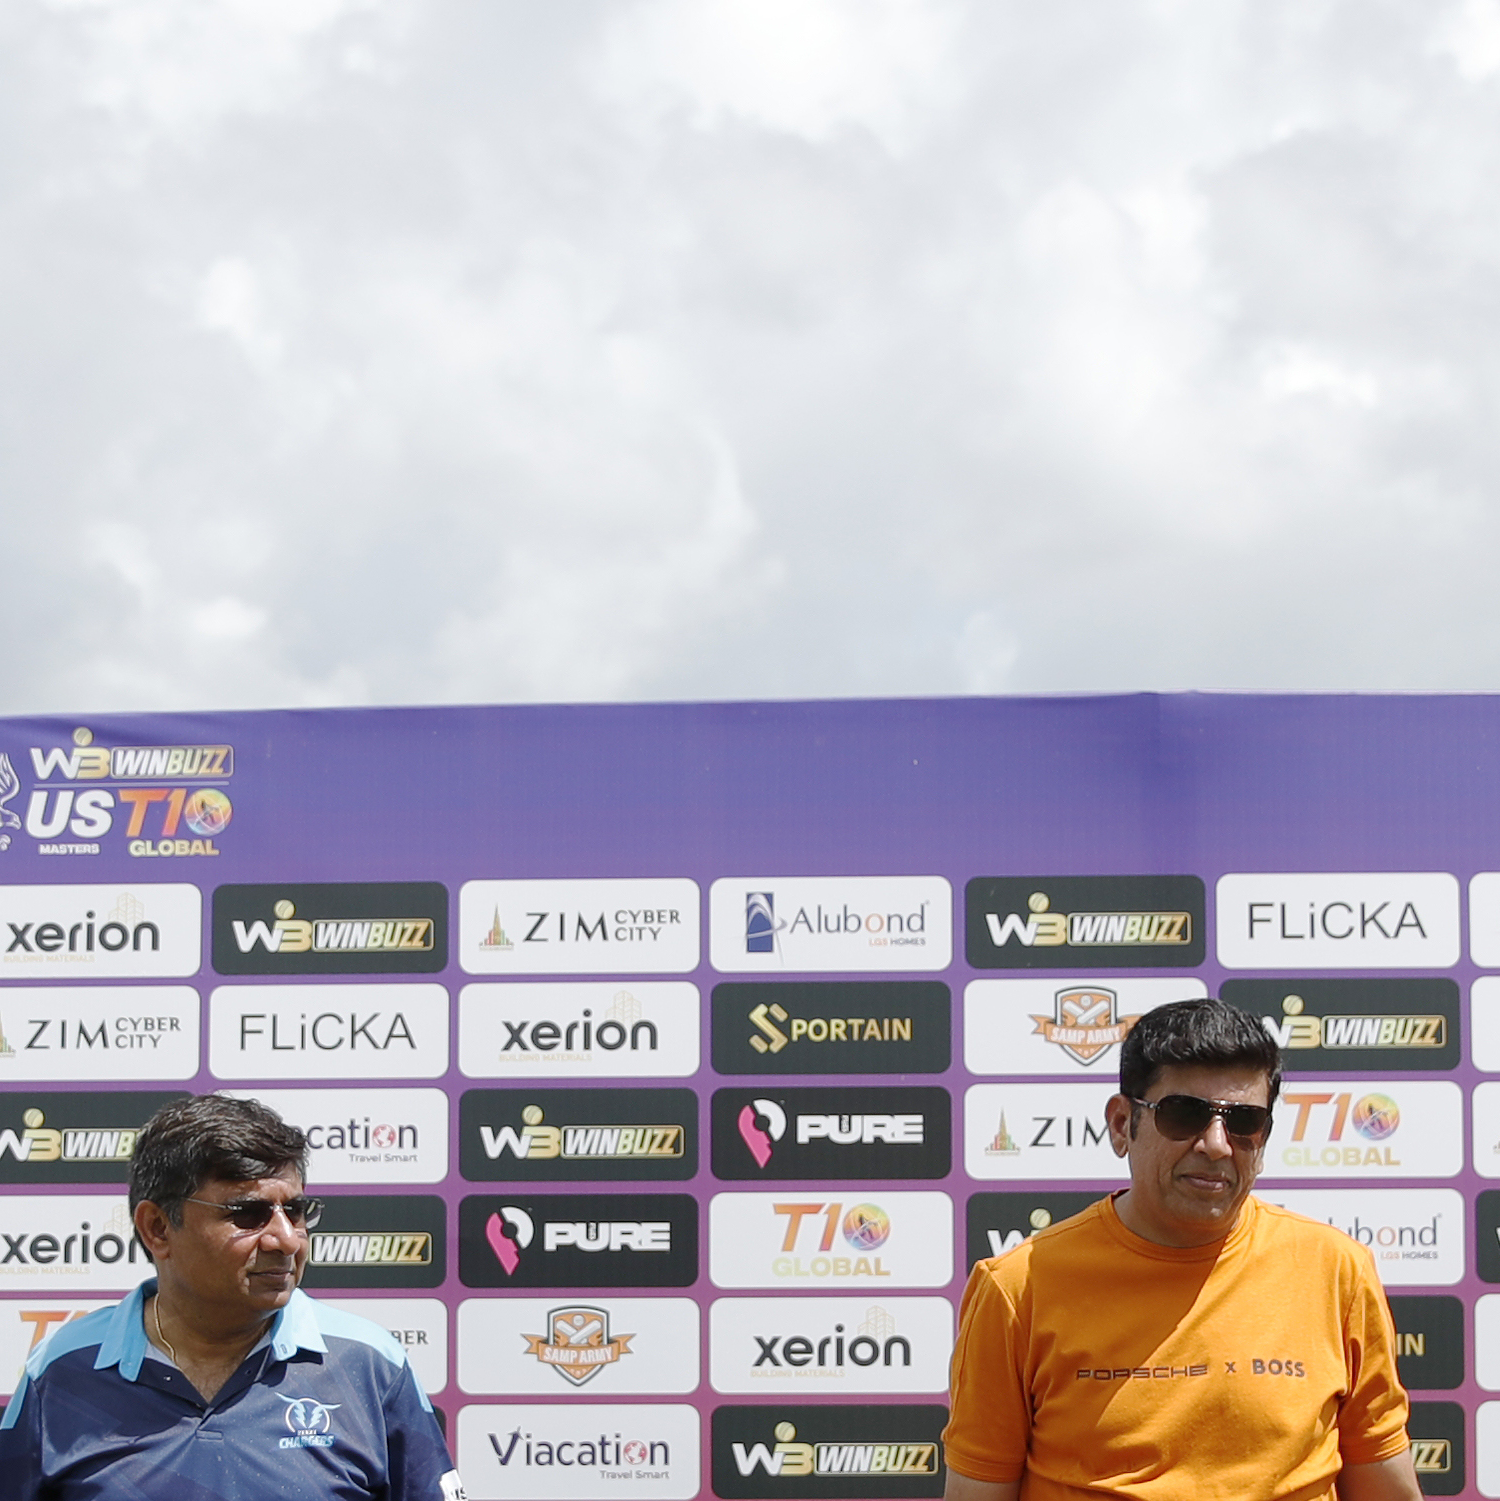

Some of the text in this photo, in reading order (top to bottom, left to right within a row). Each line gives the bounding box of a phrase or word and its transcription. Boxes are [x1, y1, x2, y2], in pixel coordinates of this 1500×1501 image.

[117, 748, 229, 776] WINBUZZ
[26, 790, 115, 838] US
[39, 844, 100, 855] MASTERS
[129, 840, 219, 856] GLOBAL
[7, 912, 159, 953] xerion
[525, 910, 681, 943] ZIM CYBER
[615, 926, 660, 942] CITY
[1069, 915, 1190, 944] WINBUZZ
[1249, 902, 1426, 940] FLiCKA
[749, 1003, 912, 1054] SPORTAIN
[797, 1114, 924, 1144] PURE
[773, 1203, 891, 1252] T10
[771, 1258, 890, 1277] GLOBAL
[542, 1344, 613, 1366] SAMP ARMY
[754, 1324, 911, 1367] xerion
[1077, 1365, 1208, 1380] PORSCHE
[1252, 1359, 1305, 1377] BOSS
[488, 1430, 669, 1468] Viacation
[818, 1445, 936, 1474] WINBUZZ
[601, 1469, 669, 1480] Travel Smart
